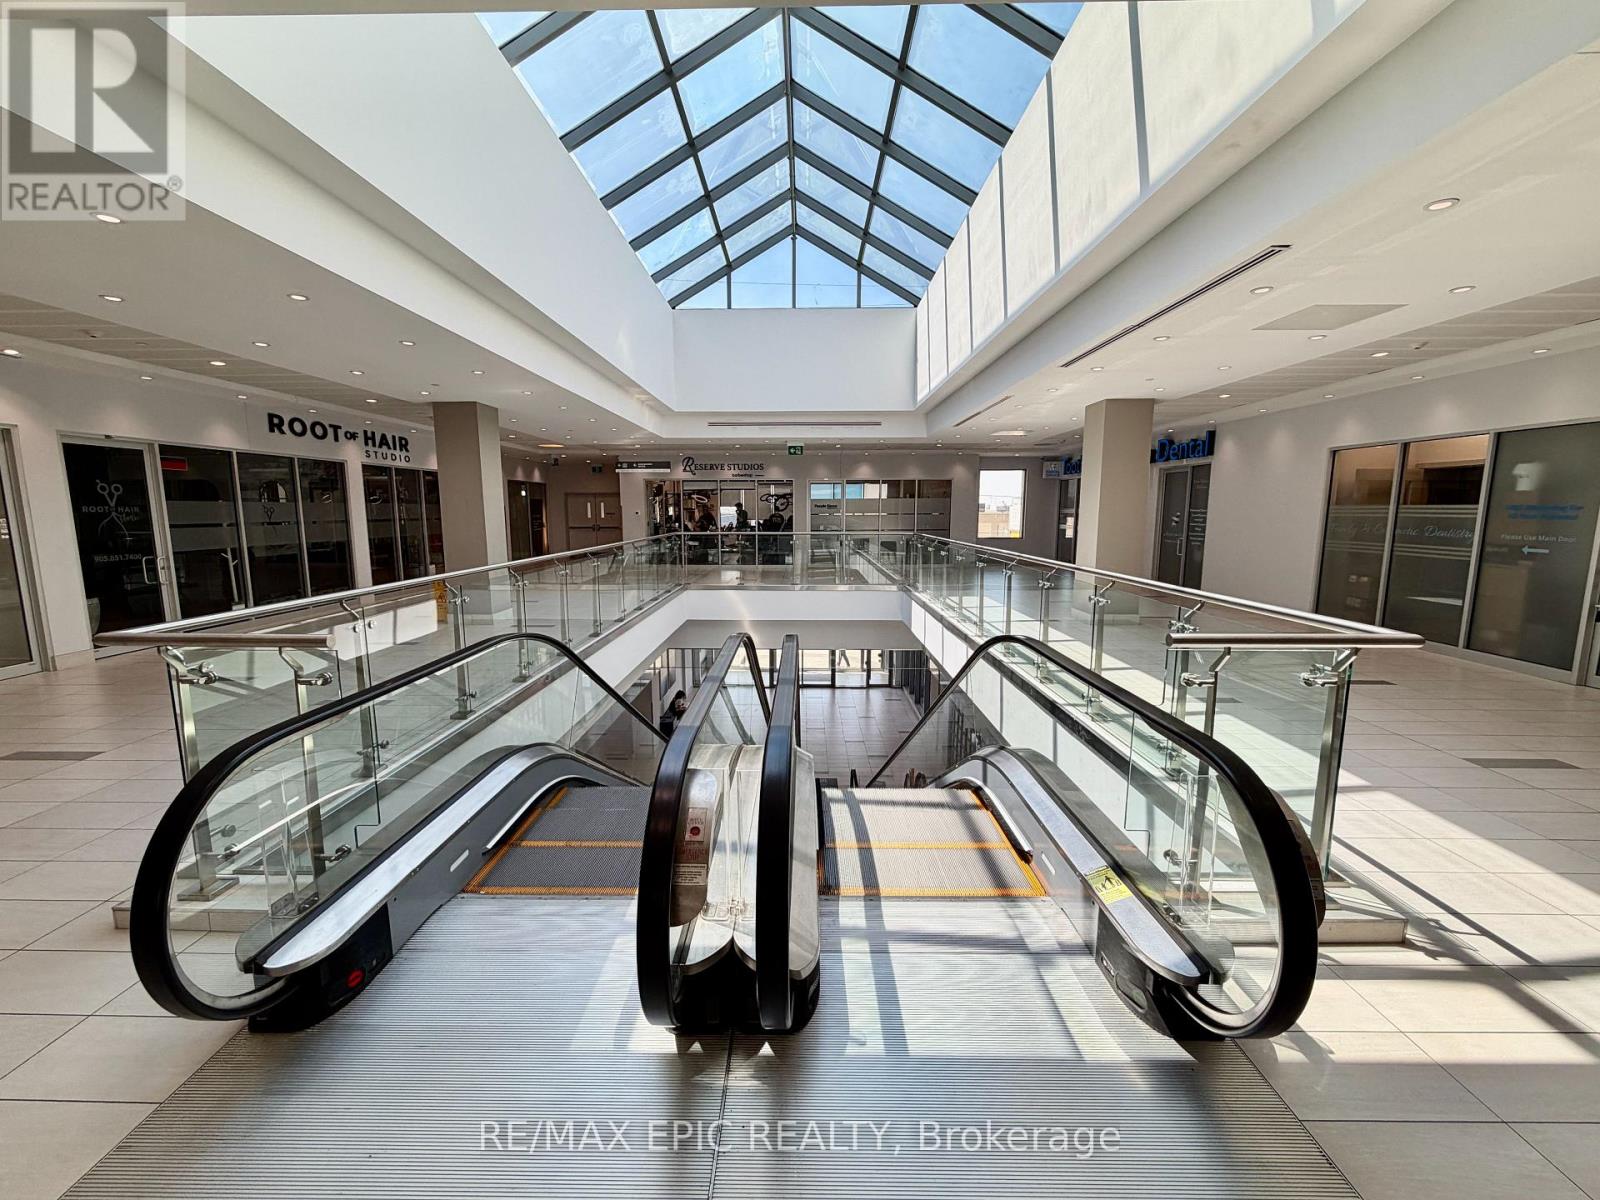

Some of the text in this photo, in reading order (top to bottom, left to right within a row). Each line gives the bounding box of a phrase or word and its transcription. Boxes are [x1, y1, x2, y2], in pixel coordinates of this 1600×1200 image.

[267, 412, 410, 453] ROOT OF HAIR
[1154, 430, 1215, 463] Dental
[365, 450, 411, 463] STUDIO
[682, 456, 765, 475] RESERVE STUDIOS
[82, 504, 109, 513] ROOT
[117, 505, 140, 513] HAIR
[1538, 534, 1557, 542] Main
